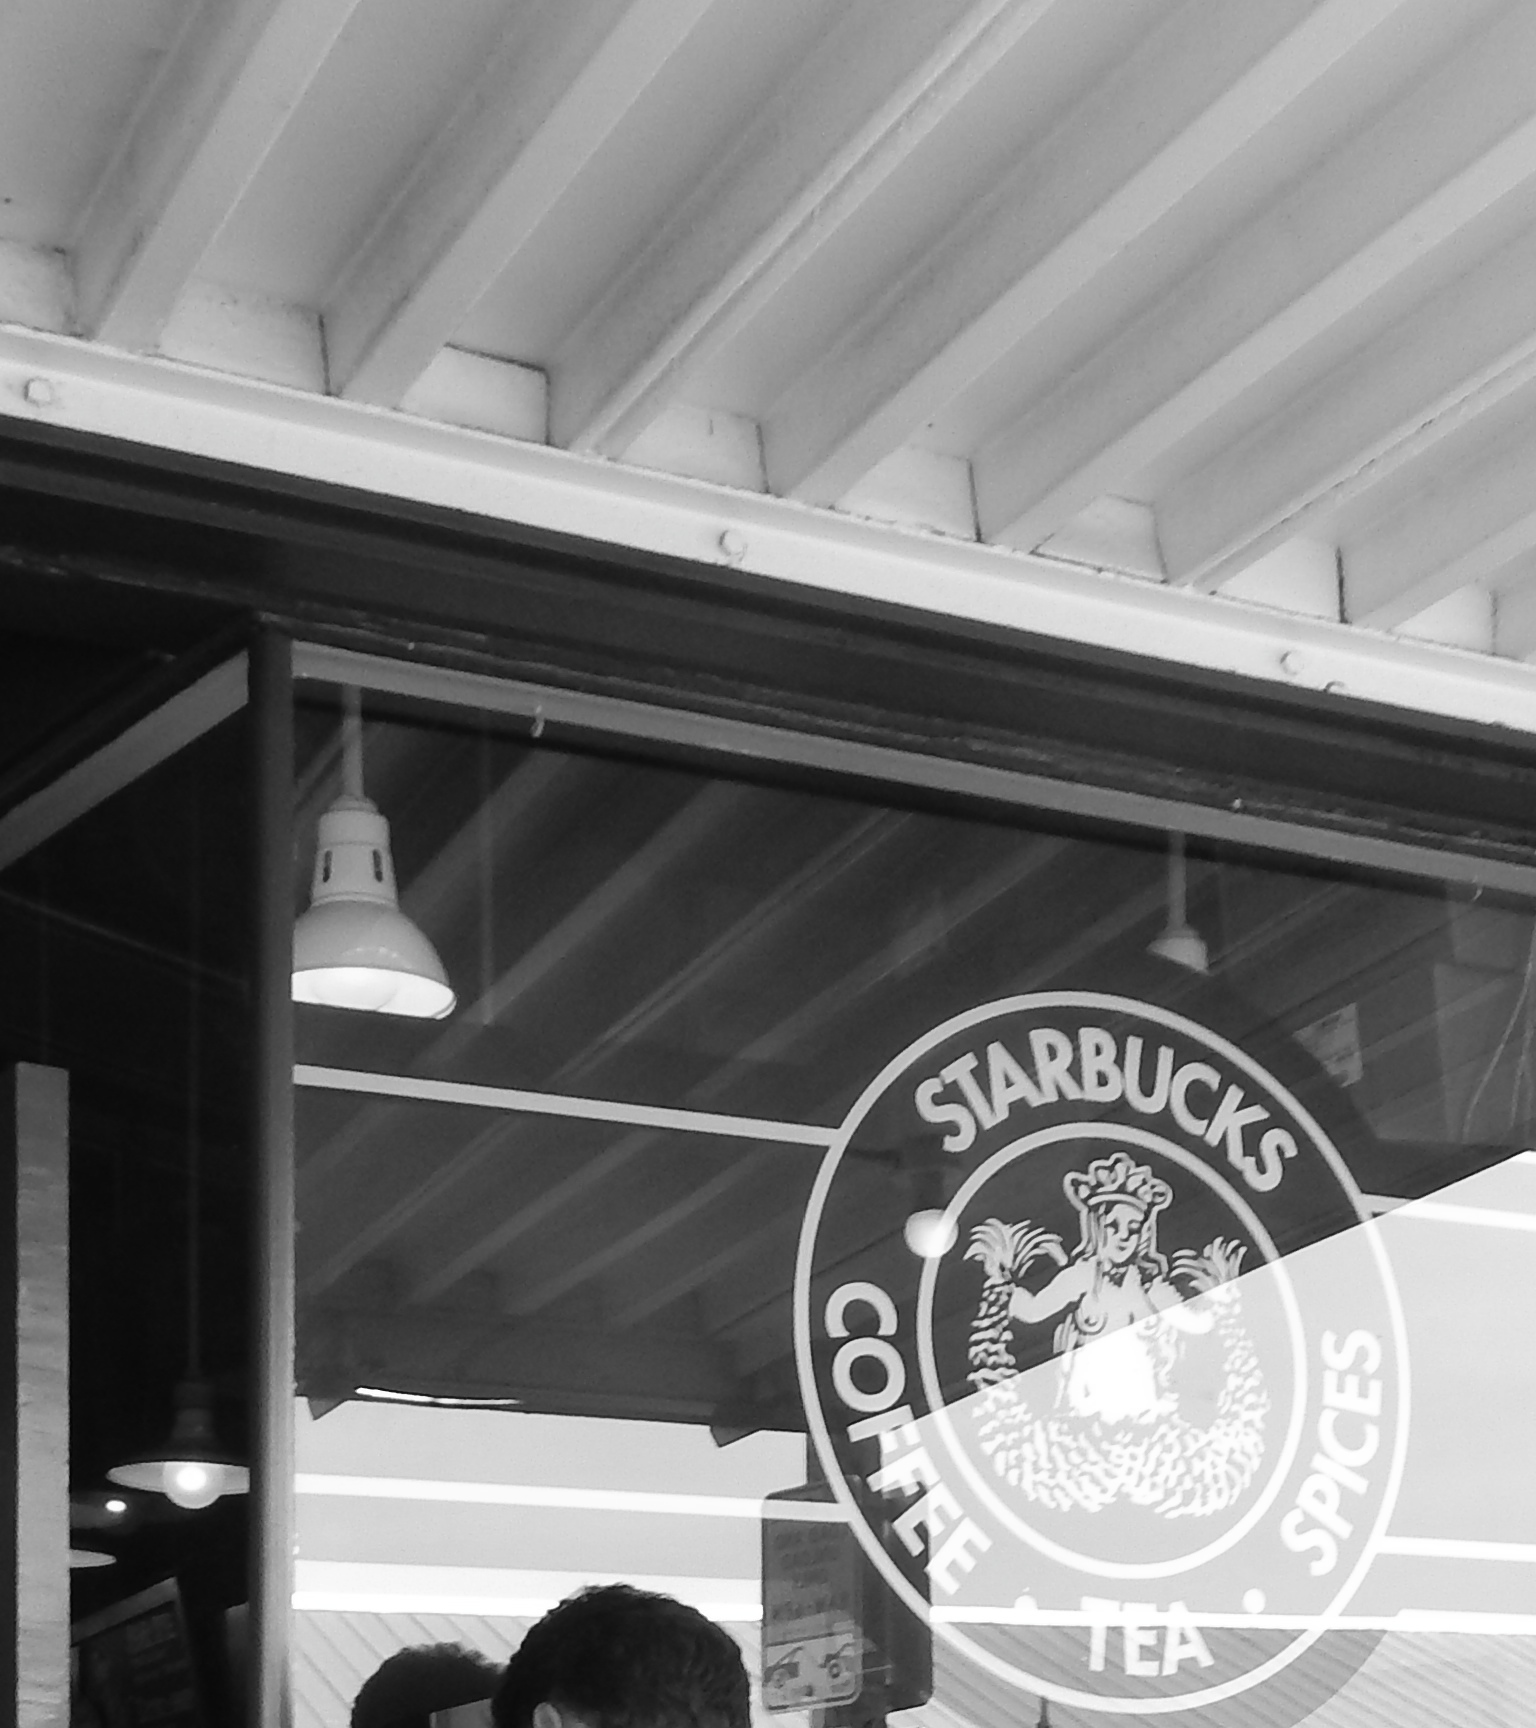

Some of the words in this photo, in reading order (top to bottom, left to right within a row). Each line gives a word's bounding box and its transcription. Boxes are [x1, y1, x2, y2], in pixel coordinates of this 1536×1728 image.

[915, 1027, 1299, 1192] STARBUCKS
[824, 1281, 992, 1595] COFFEE
[1280, 1328, 1382, 1576] SPICES
[1079, 1596, 1215, 1677] TEA
